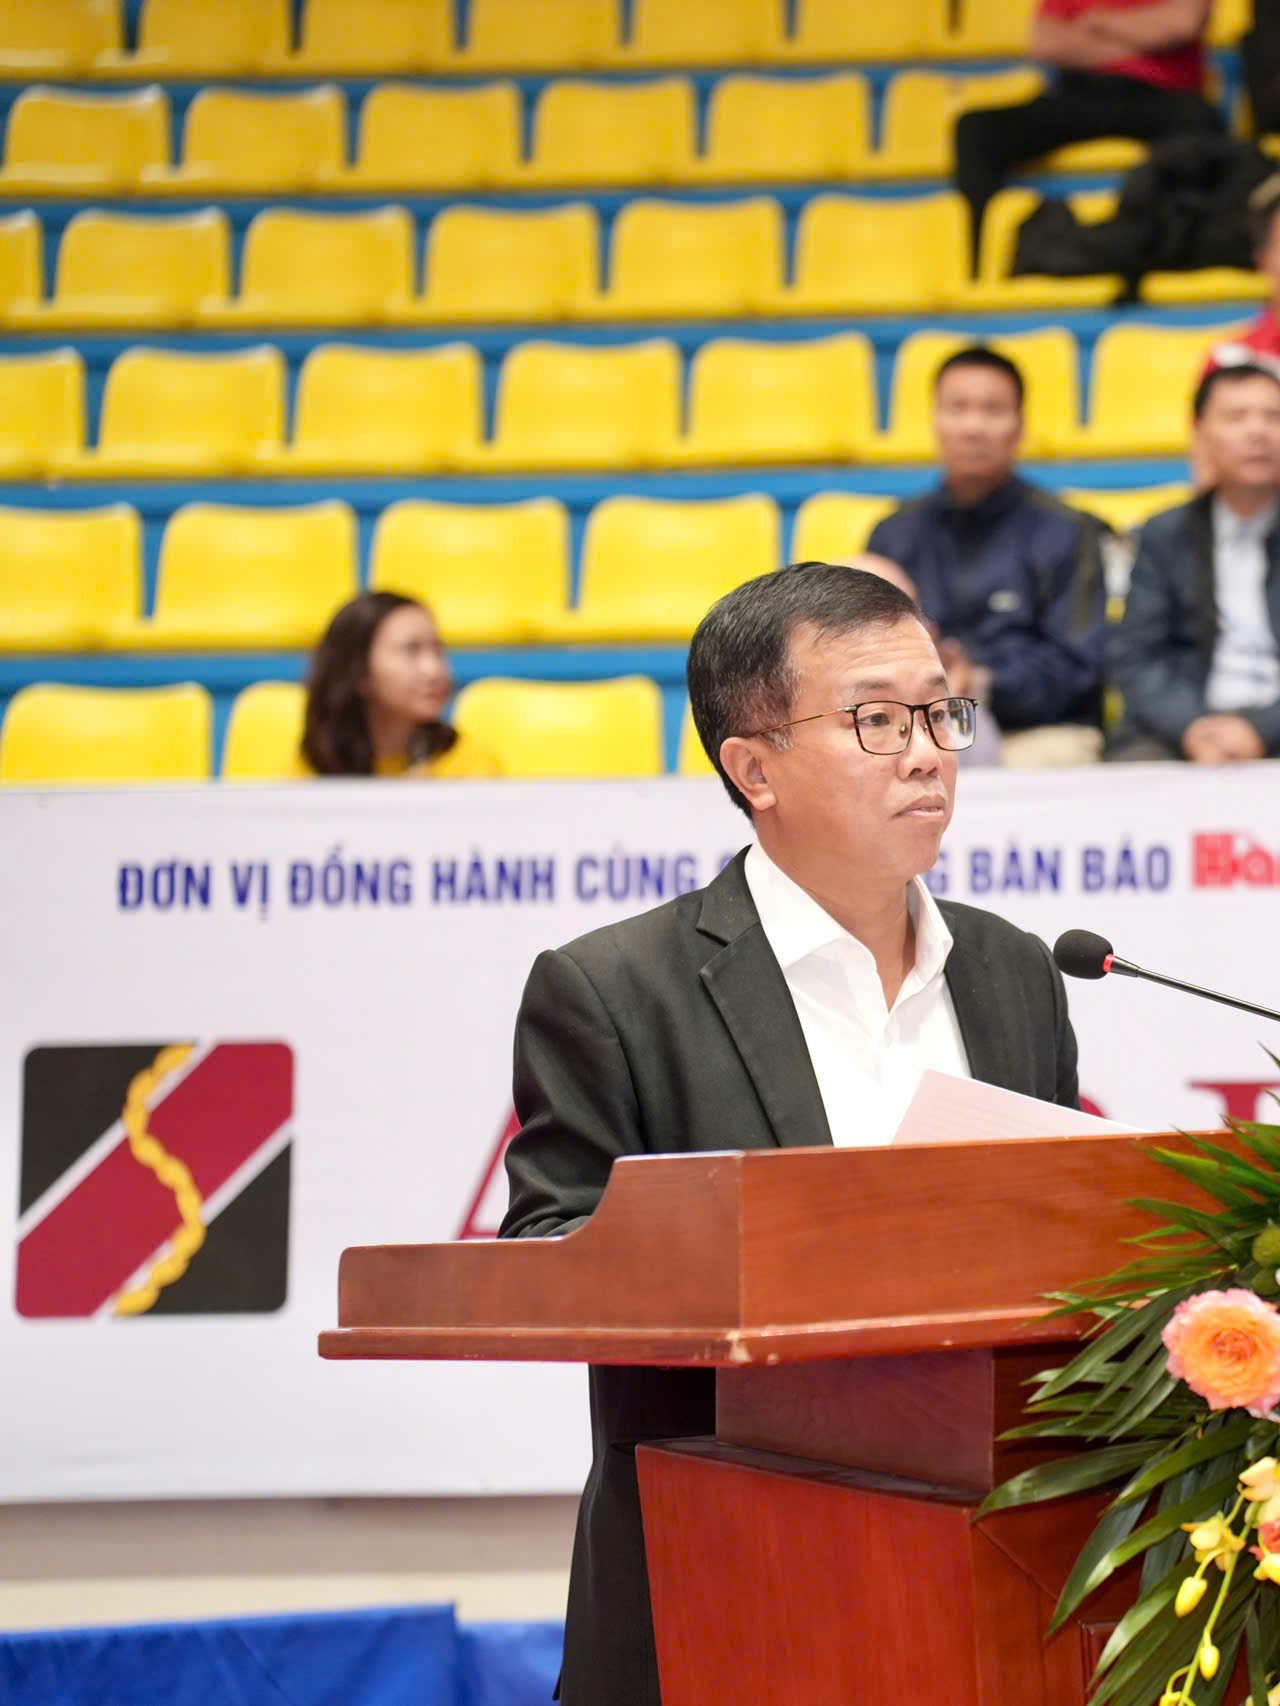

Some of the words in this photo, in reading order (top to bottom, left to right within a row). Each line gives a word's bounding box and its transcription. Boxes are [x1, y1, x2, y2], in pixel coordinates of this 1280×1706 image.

[118, 859, 211, 909] ĐƠN
[231, 862, 269, 921] VỊ
[431, 849, 555, 904] HÀNH
[1082, 838, 1172, 893] BÁO
